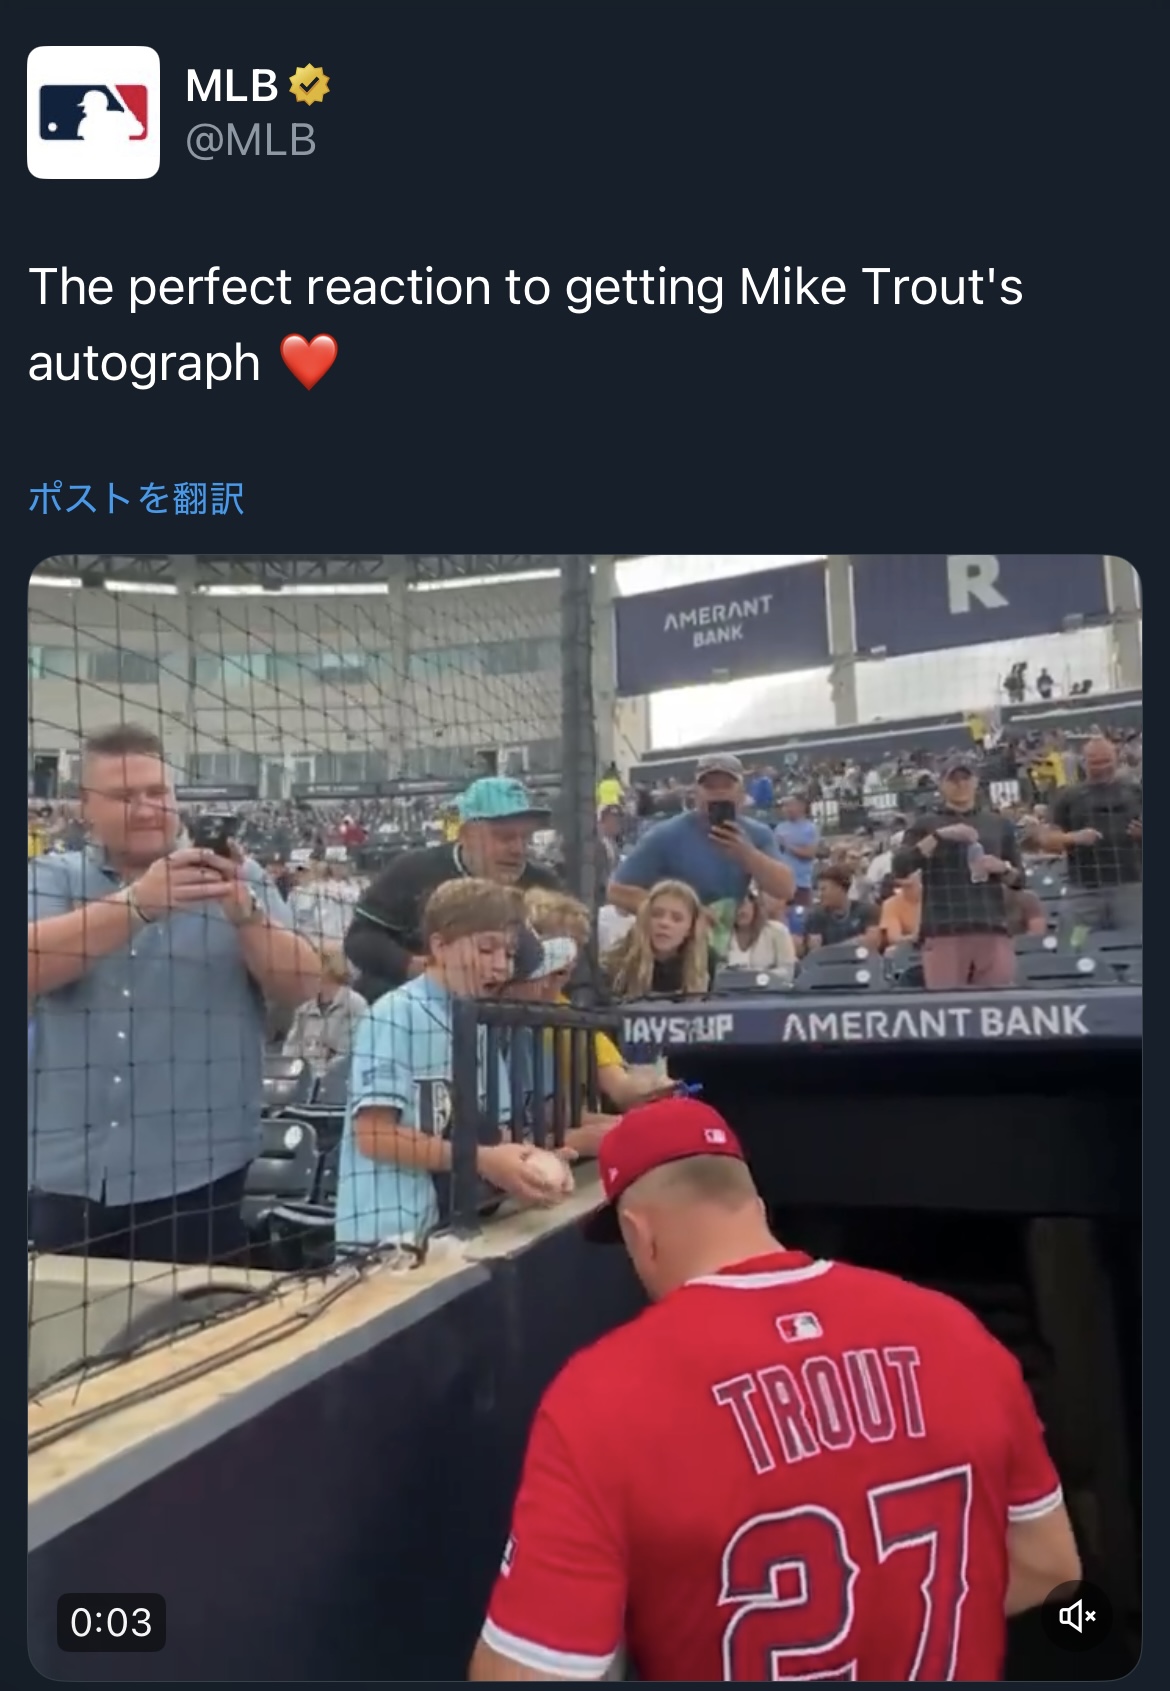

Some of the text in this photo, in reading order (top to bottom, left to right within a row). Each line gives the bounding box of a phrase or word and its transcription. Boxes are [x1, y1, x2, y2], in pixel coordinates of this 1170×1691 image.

[946, 555, 1009, 614] R
[664, 594, 773, 632] AMERANT
[693, 622, 743, 648] BANK
[782, 1004, 1089, 1041] AMERANT BANK
[713, 1346, 926, 1475] TROUT
[718, 1464, 972, 1681] 27
